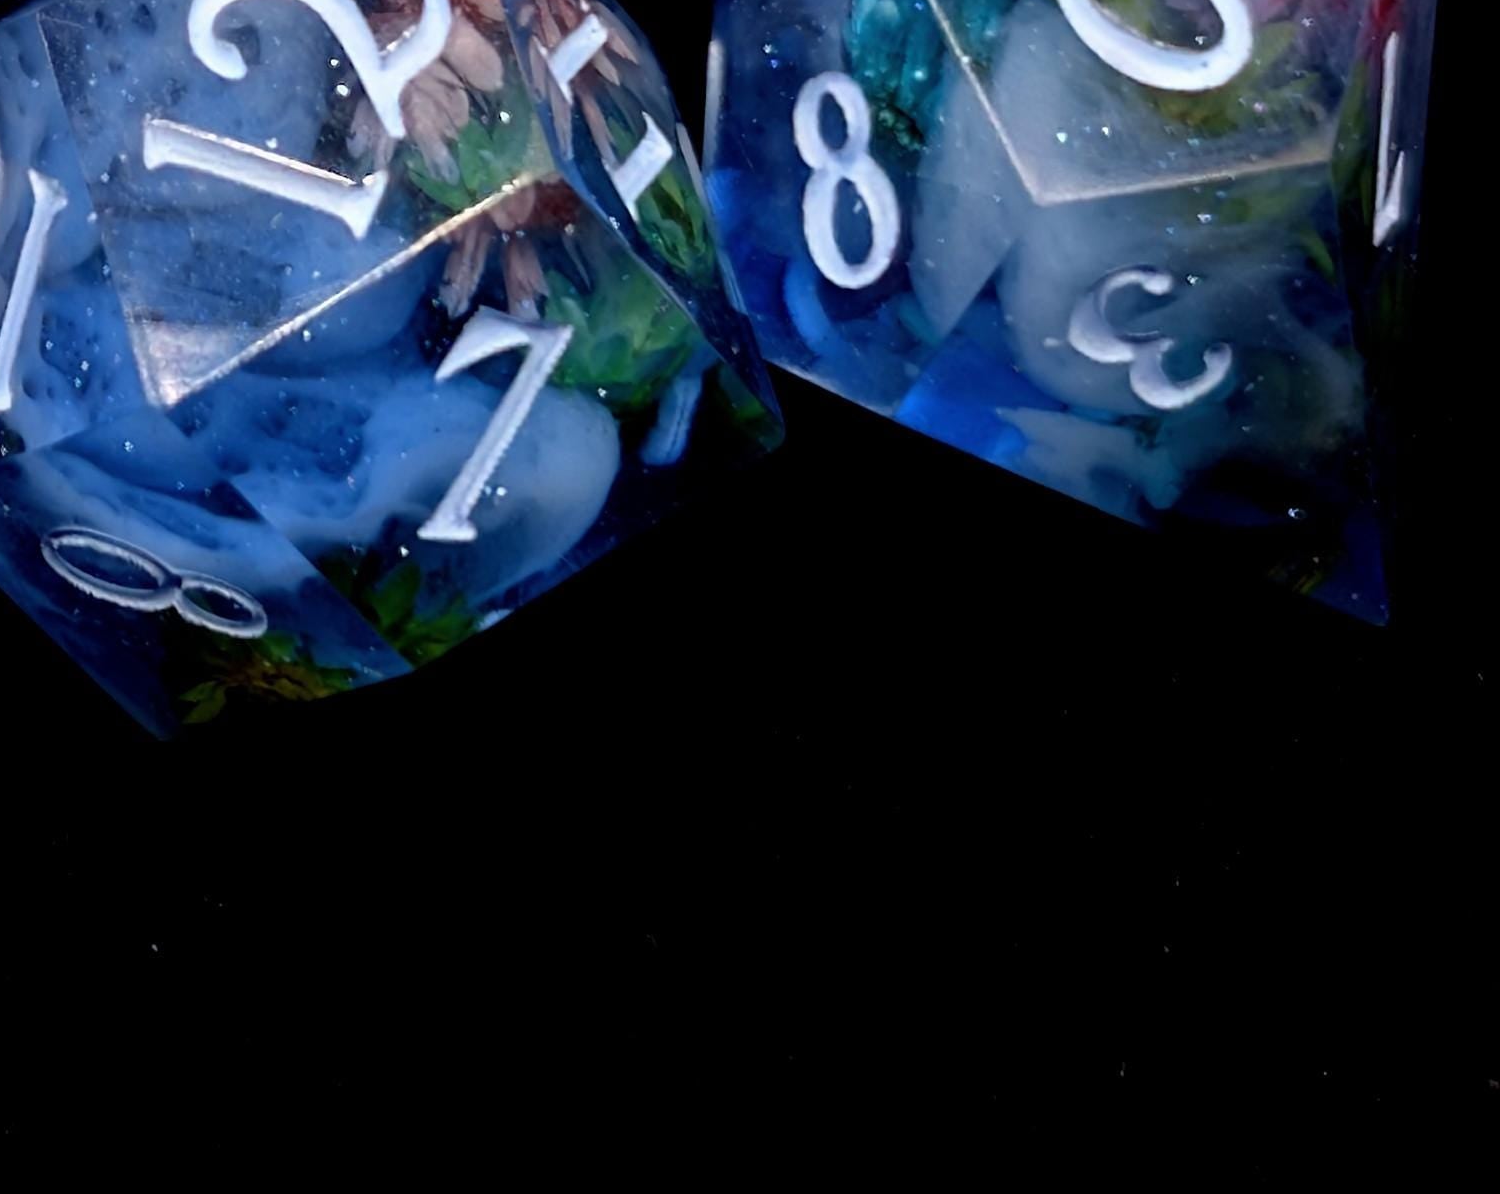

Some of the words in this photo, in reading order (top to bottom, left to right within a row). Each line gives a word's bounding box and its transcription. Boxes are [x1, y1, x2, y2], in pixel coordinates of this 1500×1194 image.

[792, 71, 901, 290] 8
[416, 304, 576, 544] 7
[39, 525, 269, 639] 8
